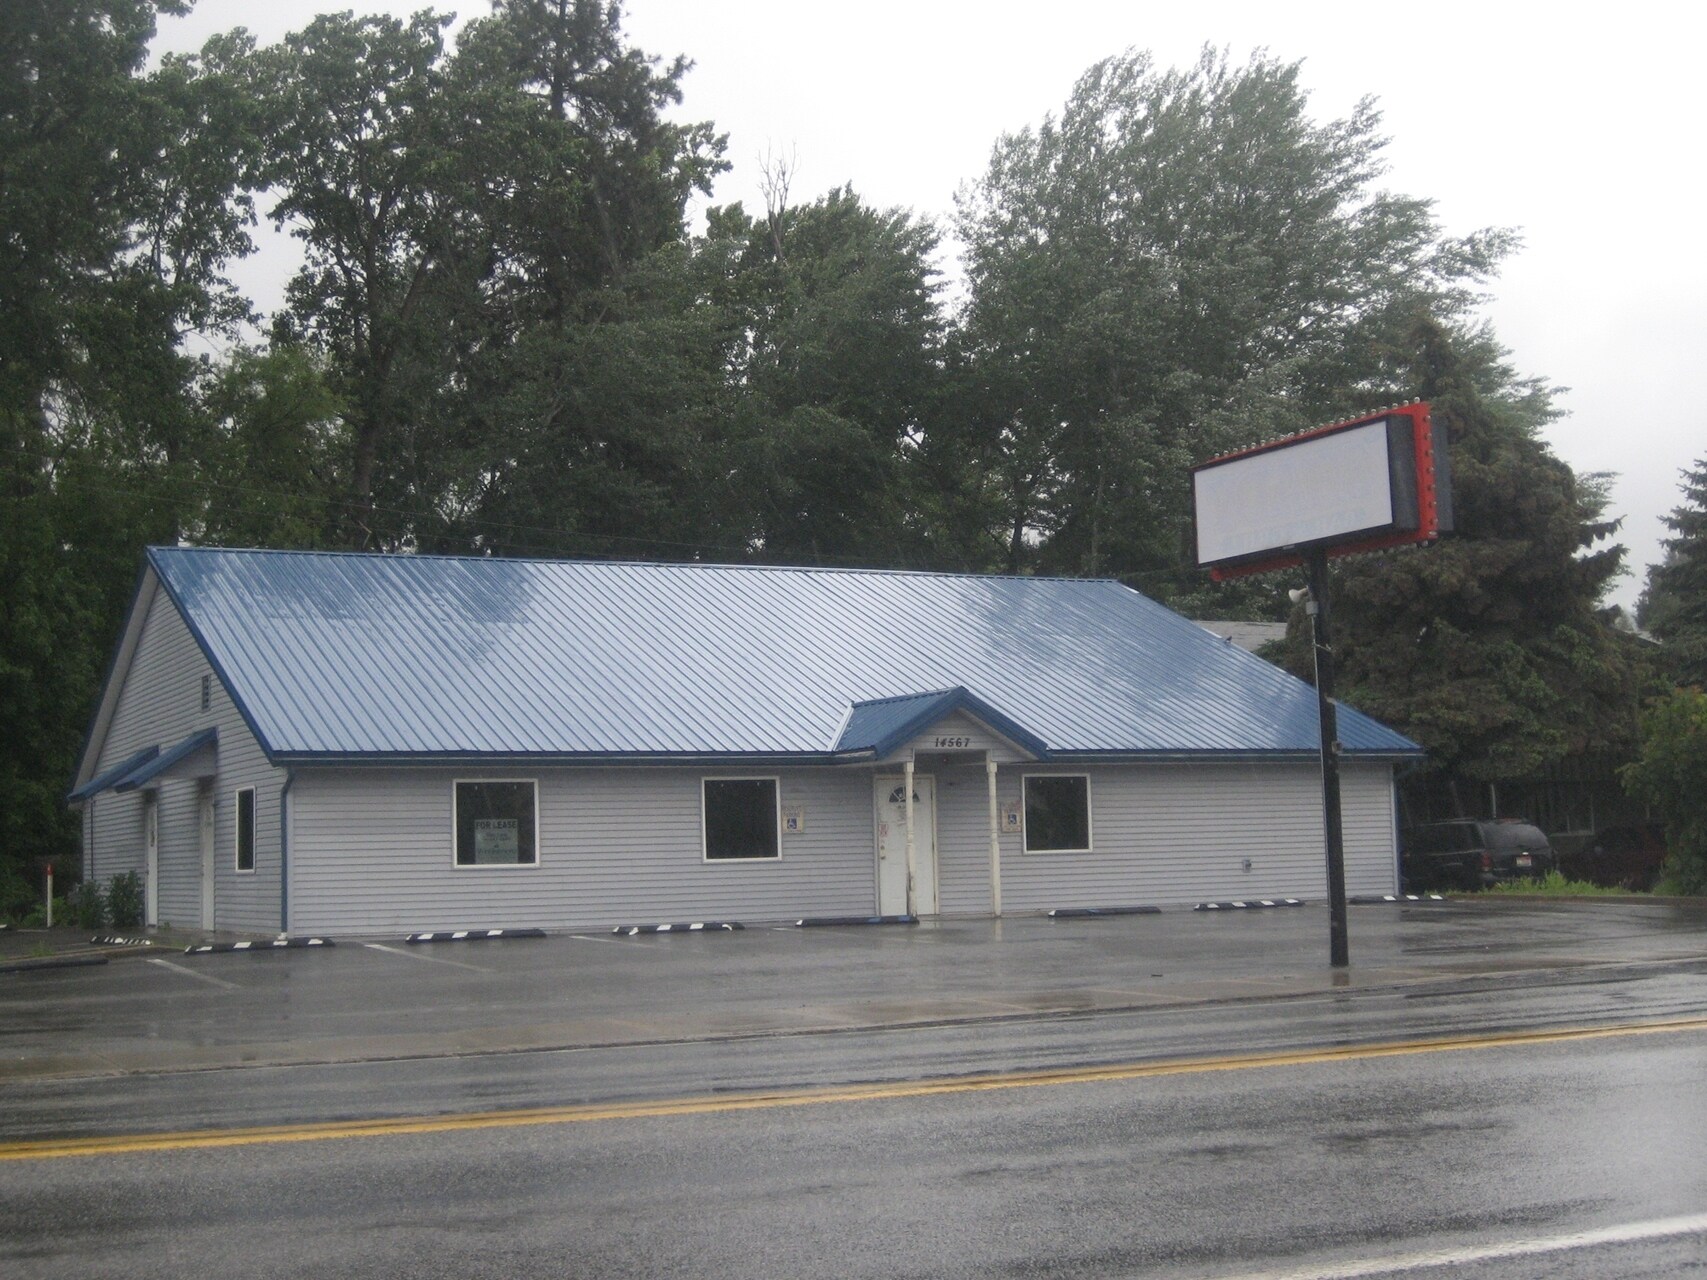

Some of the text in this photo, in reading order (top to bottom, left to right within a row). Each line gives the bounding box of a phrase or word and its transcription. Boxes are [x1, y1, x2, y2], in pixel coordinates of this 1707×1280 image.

[935, 737, 970, 748] 14567
[476, 821, 516, 829] FOR LEASE
